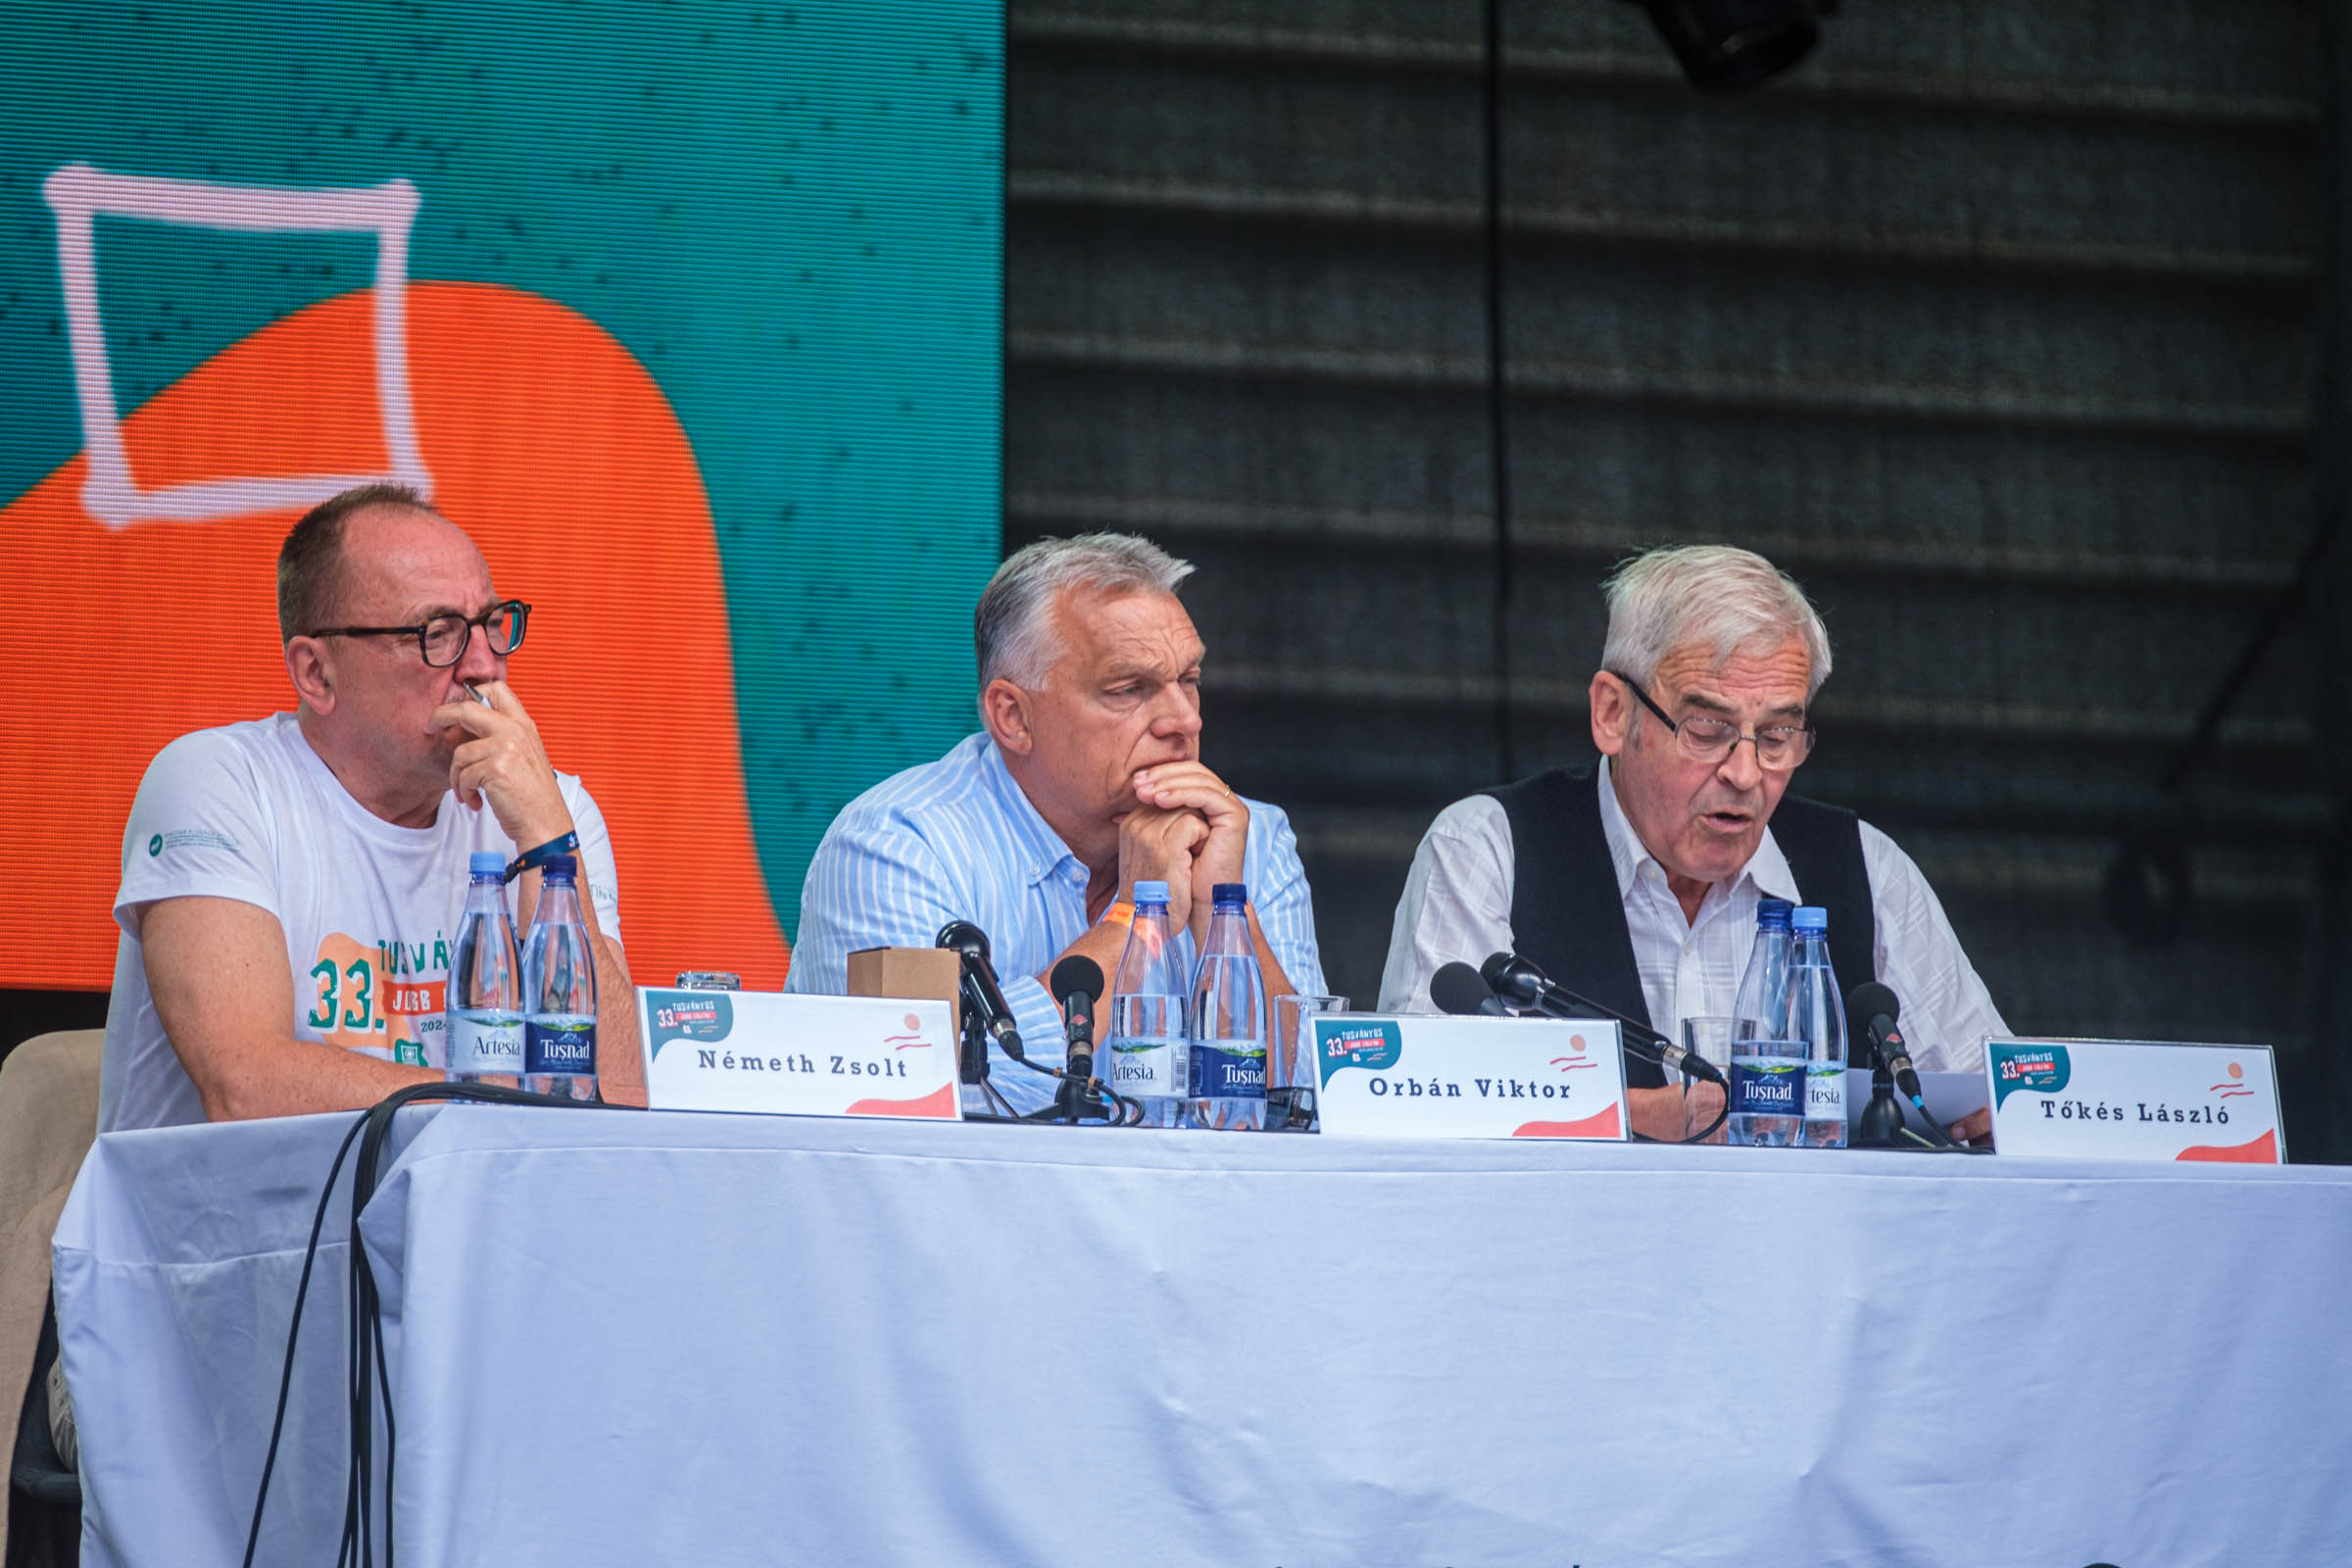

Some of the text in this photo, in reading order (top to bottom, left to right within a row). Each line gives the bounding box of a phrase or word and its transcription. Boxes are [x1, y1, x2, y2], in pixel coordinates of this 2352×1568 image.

[378, 929, 452, 975] TUSVÁ
[308, 958, 386, 1032] 33.
[657, 1007, 678, 1027] 33.
[1342, 1027, 1383, 1040] TUSVÁNYOS
[472, 1036, 520, 1055] Artesia
[1326, 1037, 1348, 1056] 33.
[698, 1050, 907, 1077] Németh Zsolt
[1112, 1061, 1153, 1081] Artesia
[2000, 1060, 2021, 1080] 33.
[1369, 1077, 1571, 1099] Orbán Viktor
[1805, 1088, 1840, 1104] tesia
[2040, 1100, 2230, 1125] Tőkés László
